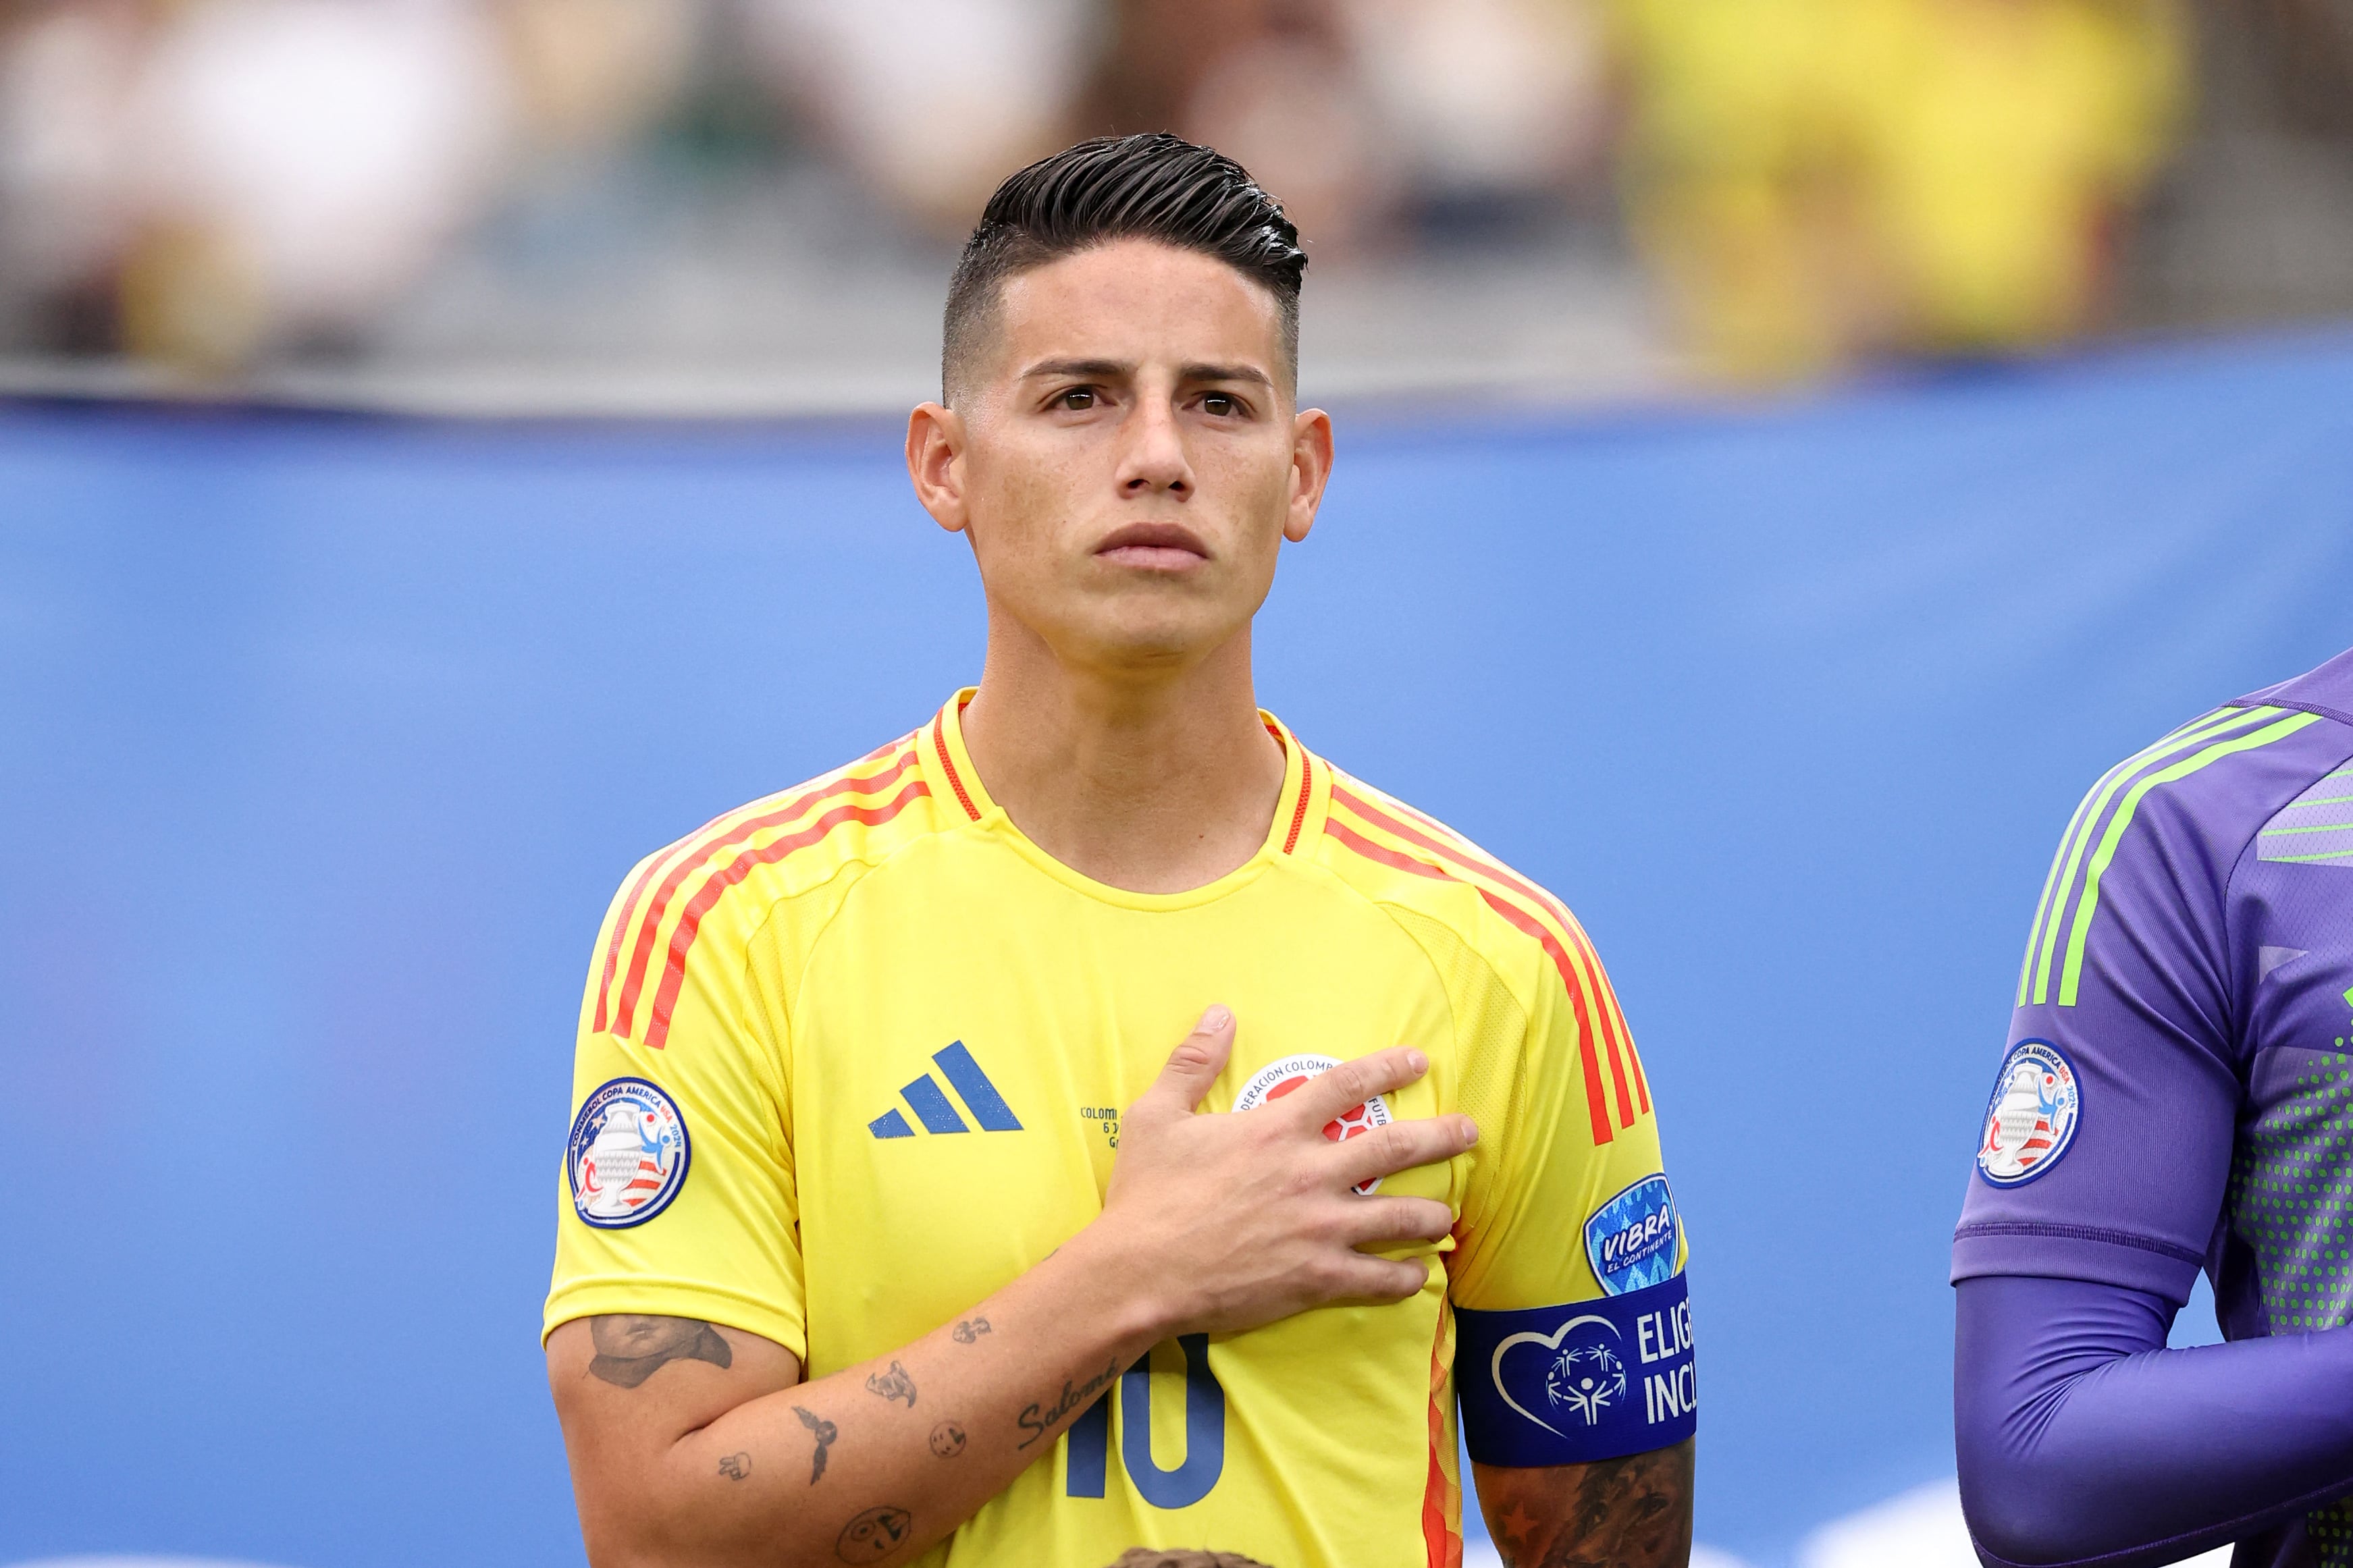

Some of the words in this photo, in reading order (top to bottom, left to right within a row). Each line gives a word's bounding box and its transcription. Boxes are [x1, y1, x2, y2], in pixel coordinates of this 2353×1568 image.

[1240, 1066, 1284, 1111] DERACIÓN
[2013, 1047, 2030, 1060] COPA
[2031, 1047, 2061, 1069] AMERICA
[2059, 1066, 2070, 1085] USA
[2066, 1085, 2076, 1109] 2024
[573, 1097, 602, 1147] CONMEBOL
[602, 1086, 623, 1100] COPA
[625, 1085, 661, 1109] AMERICA
[660, 1104, 674, 1124] USA
[670, 1124, 681, 1147] 2024
[1080, 1107, 1117, 1120] COLOM
[1103, 1122, 1109, 1134] 6
[1368, 1098, 1387, 1126] FÚTB
[1604, 1204, 1670, 1262] VIBRA
[1608, 1262, 1620, 1274] EL
[1622, 1229, 1672, 1267] CONTINENTE
[1637, 1296, 1694, 1364] ELIG
[1066, 1332, 1225, 1510] 10
[1643, 1359, 1697, 1425] INCL
